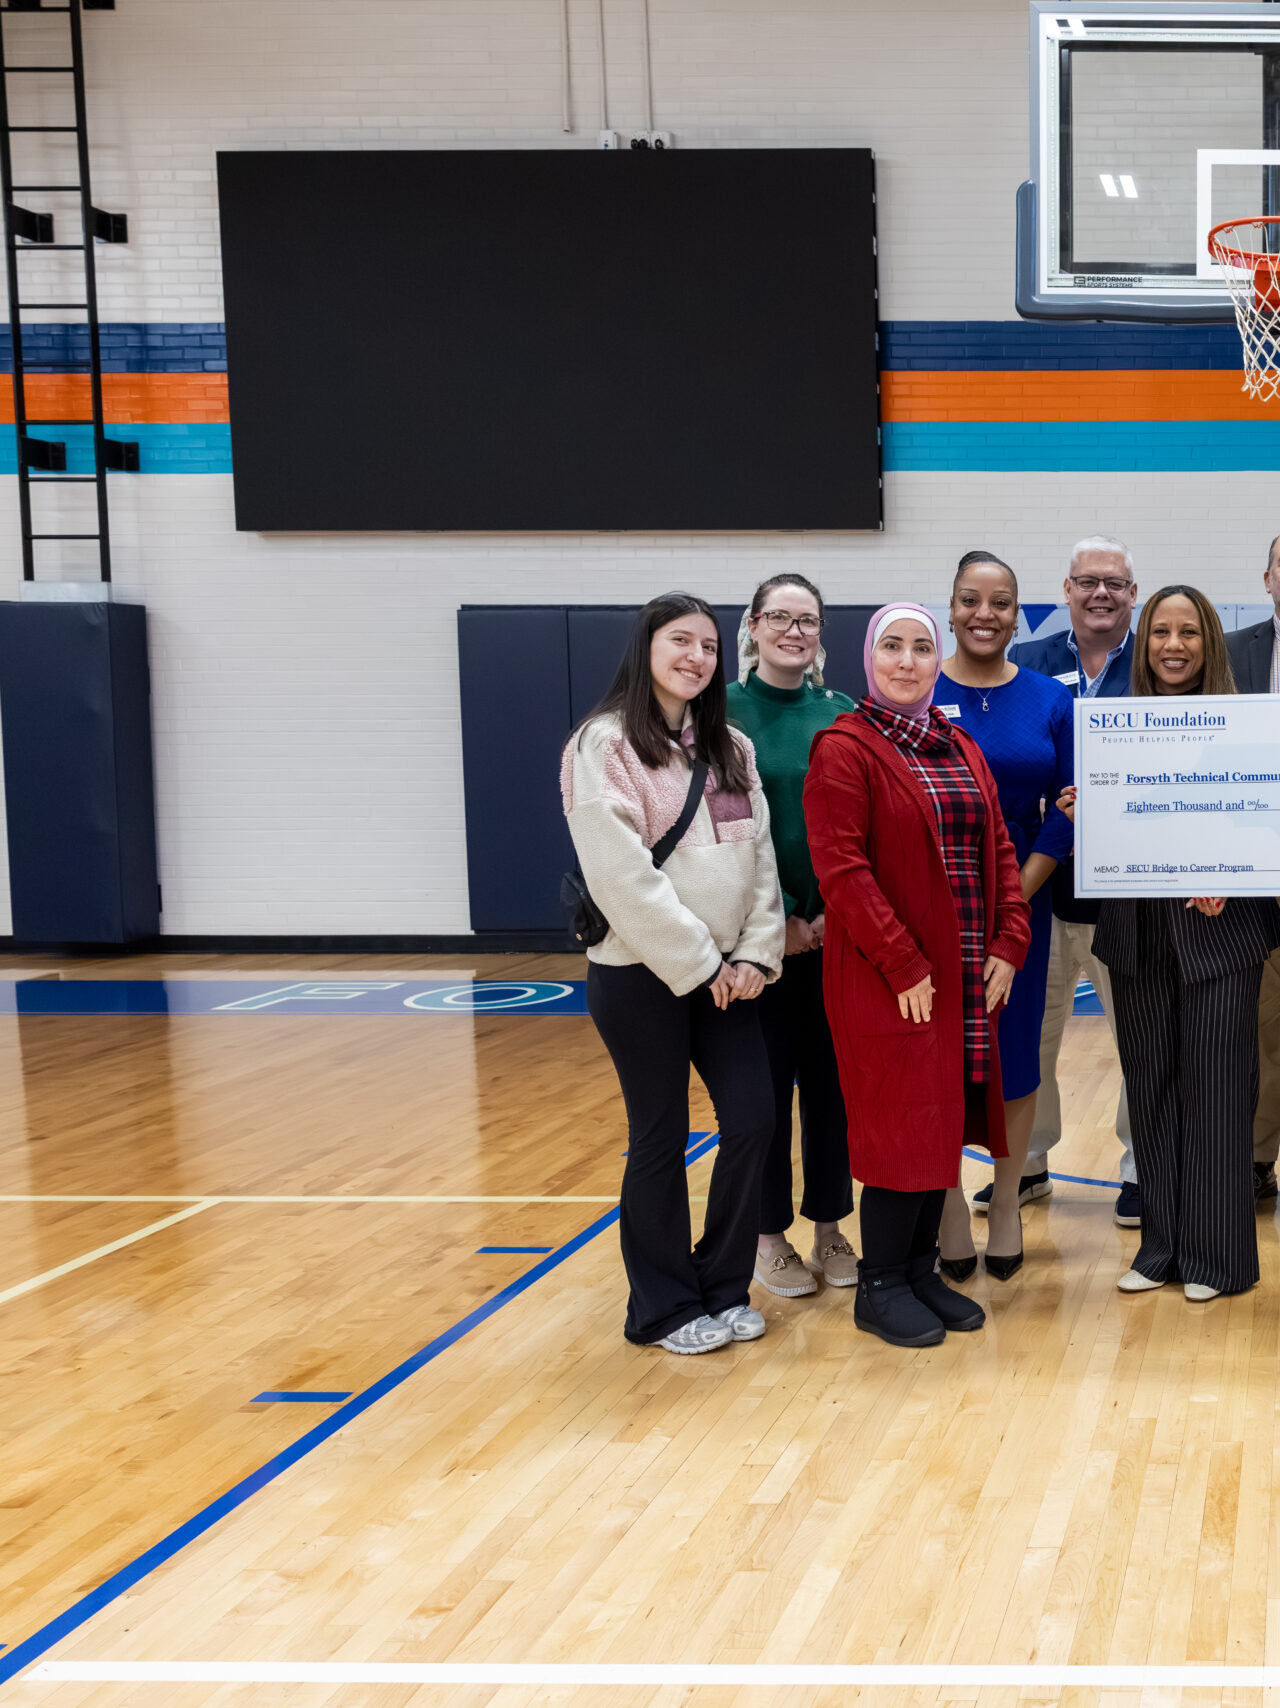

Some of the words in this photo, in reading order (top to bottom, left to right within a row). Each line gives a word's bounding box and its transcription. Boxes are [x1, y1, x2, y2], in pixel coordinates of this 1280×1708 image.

[1089, 712, 1139, 729] SECU
[1144, 711, 1226, 728] Foundation
[1126, 773, 1170, 785] Forsyth
[1173, 772, 1229, 783] Technical
[1126, 801, 1170, 813] Eighteen
[1173, 800, 1223, 812] Thousand
[1225, 800, 1245, 811] and
[1093, 865, 1120, 874] MEMO
[1126, 864, 1150, 873] SECU
[1152, 864, 1178, 874] Bridge
[1180, 864, 1188, 872] to
[1190, 864, 1216, 872] Career
[1218, 863, 1254, 874] Program
[211, 982, 574, 1011] FO
